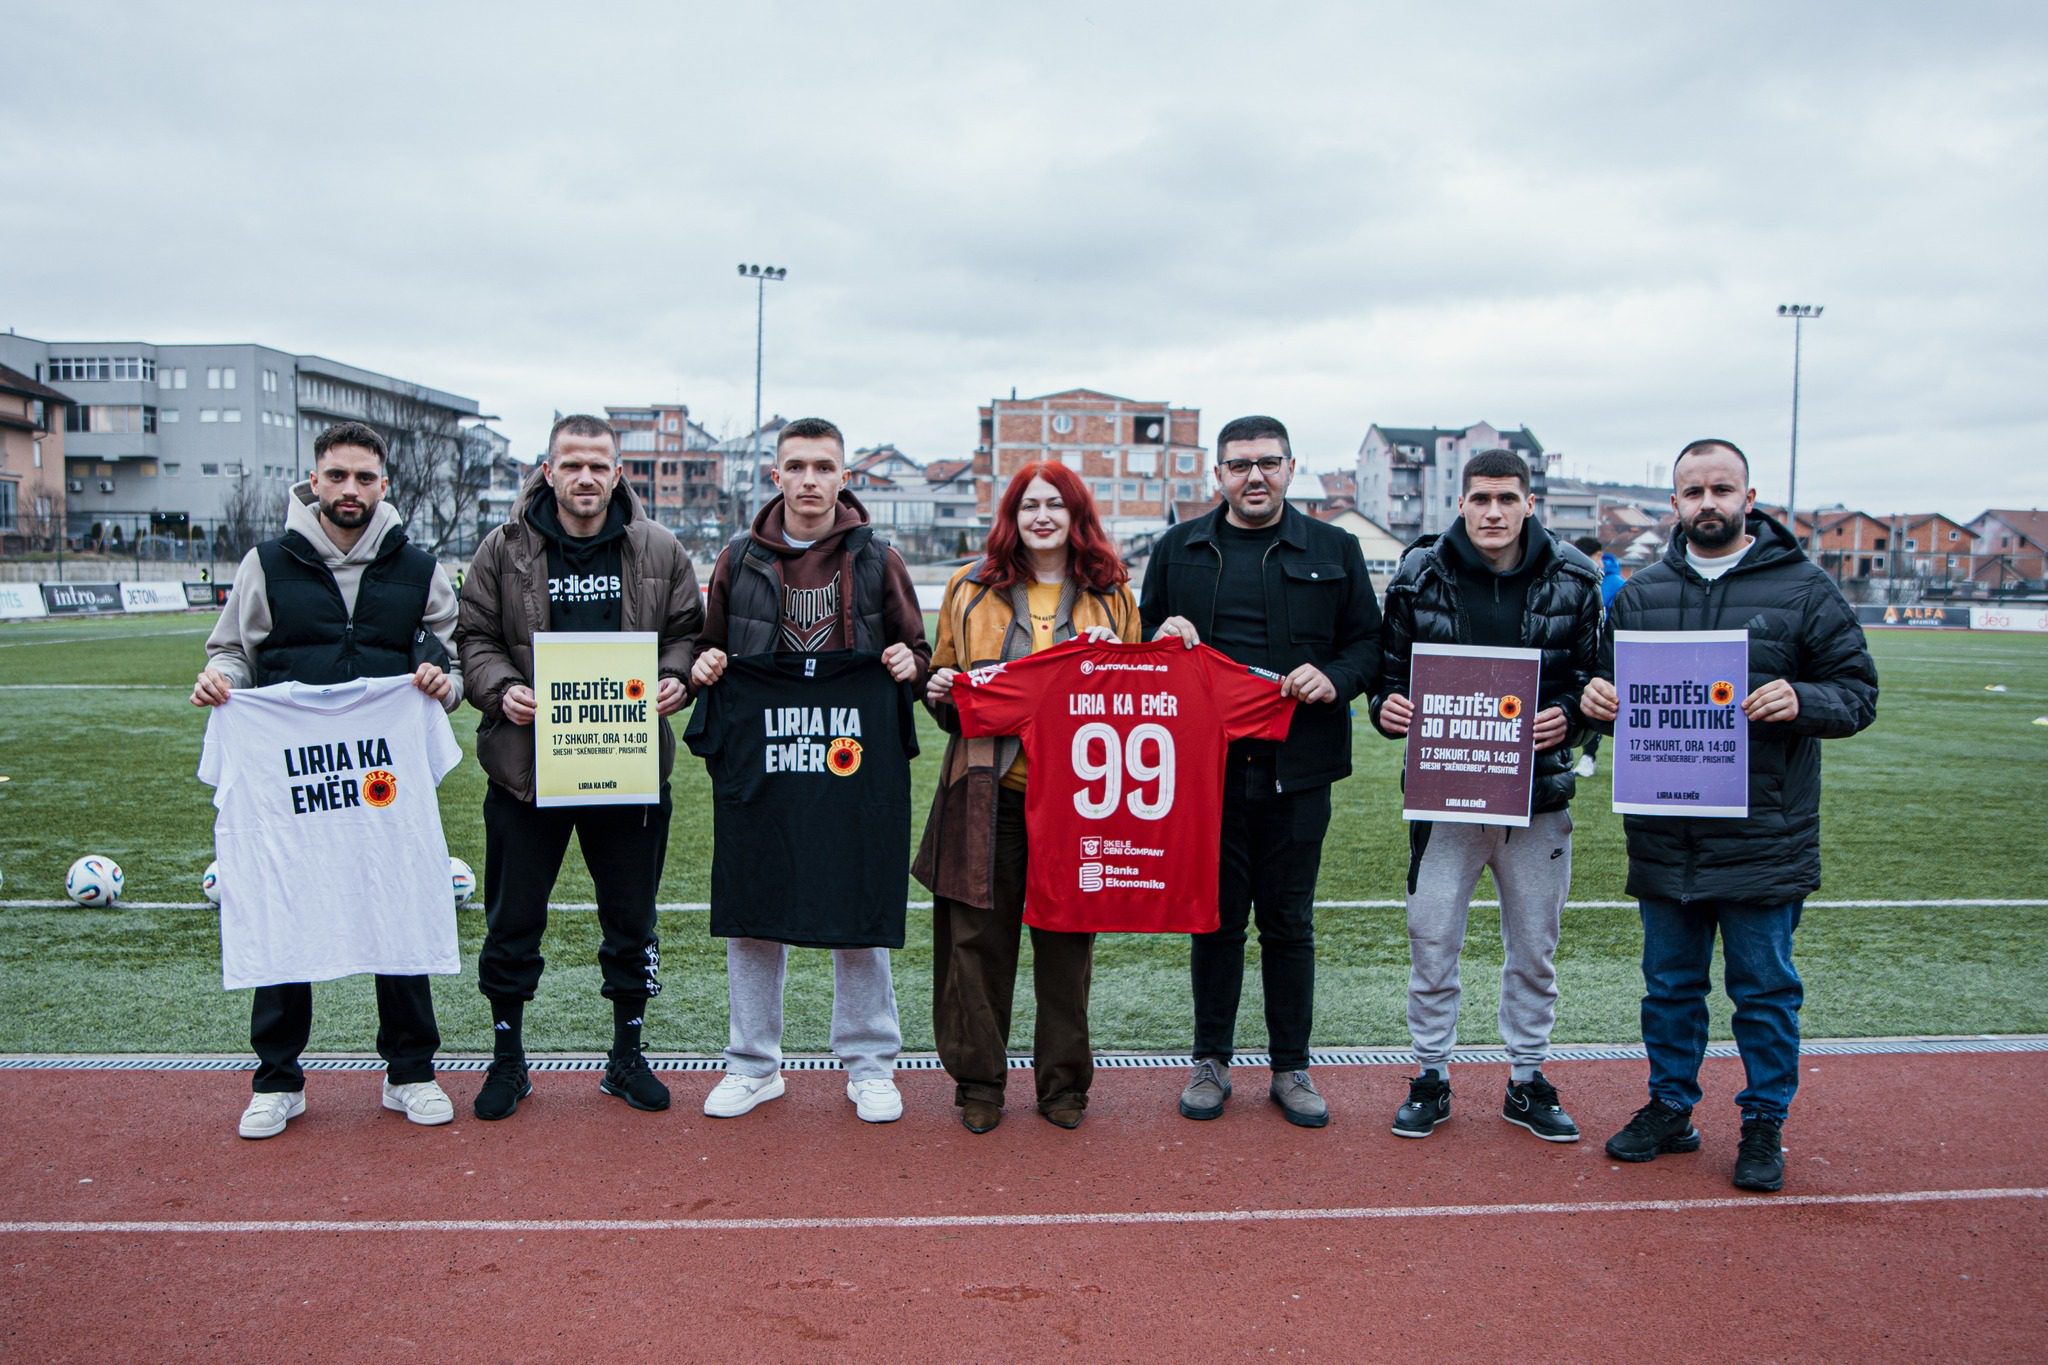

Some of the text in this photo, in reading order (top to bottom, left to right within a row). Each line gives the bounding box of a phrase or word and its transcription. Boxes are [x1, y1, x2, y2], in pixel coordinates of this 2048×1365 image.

[548, 574, 621, 594] adidas
[54, 585, 96, 606] intro
[552, 591, 621, 602] PRTSWER
[783, 570, 840, 632] LOODLINE
[1095, 664, 1154, 672] AUTOVILLAGE
[551, 677, 623, 700] DREJTËSI
[1629, 680, 1709, 704] DREJTËSI
[551, 700, 647, 724] JO POLITIKË
[1069, 691, 1178, 717] LIRIA KA EMËR
[1422, 692, 1500, 717] DREJTËSI
[764, 707, 862, 737] LIRIA KA
[1629, 704, 1736, 729] JO POLITIKË
[552, 732, 648, 745] 17 SHKURT, ORA 14:00
[1421, 717, 1522, 743] JO POLITIKË
[552, 748, 573, 756] SHESHI
[618, 746, 648, 754] PRISHTINË
[1630, 739, 1736, 752] 17 SHKURT, ORA 14:00
[284, 738, 393, 777] LIRIA KA
[765, 737, 826, 773] EMËR
[1420, 747, 1520, 764] 17 SHKURT, ORA 14:00
[1630, 754, 1652, 762] SHESHI
[1702, 755, 1736, 763] PRISHTINË
[1071, 722, 1176, 821] 99
[1420, 762, 1441, 770] SHESHI
[1488, 765, 1519, 775] PRISHTINË
[291, 774, 361, 814] EMËR
[578, 782, 593, 790] LIRIA
[601, 780, 617, 789] EMËR
[1461, 799, 1469, 807] KA
[1683, 791, 1699, 800] EMËR
[1103, 840, 1131, 848] SKELE
[1124, 848, 1164, 857] COMPANY
[1105, 865, 1139, 875] Banka
[1105, 878, 1165, 889] Ekonomike
